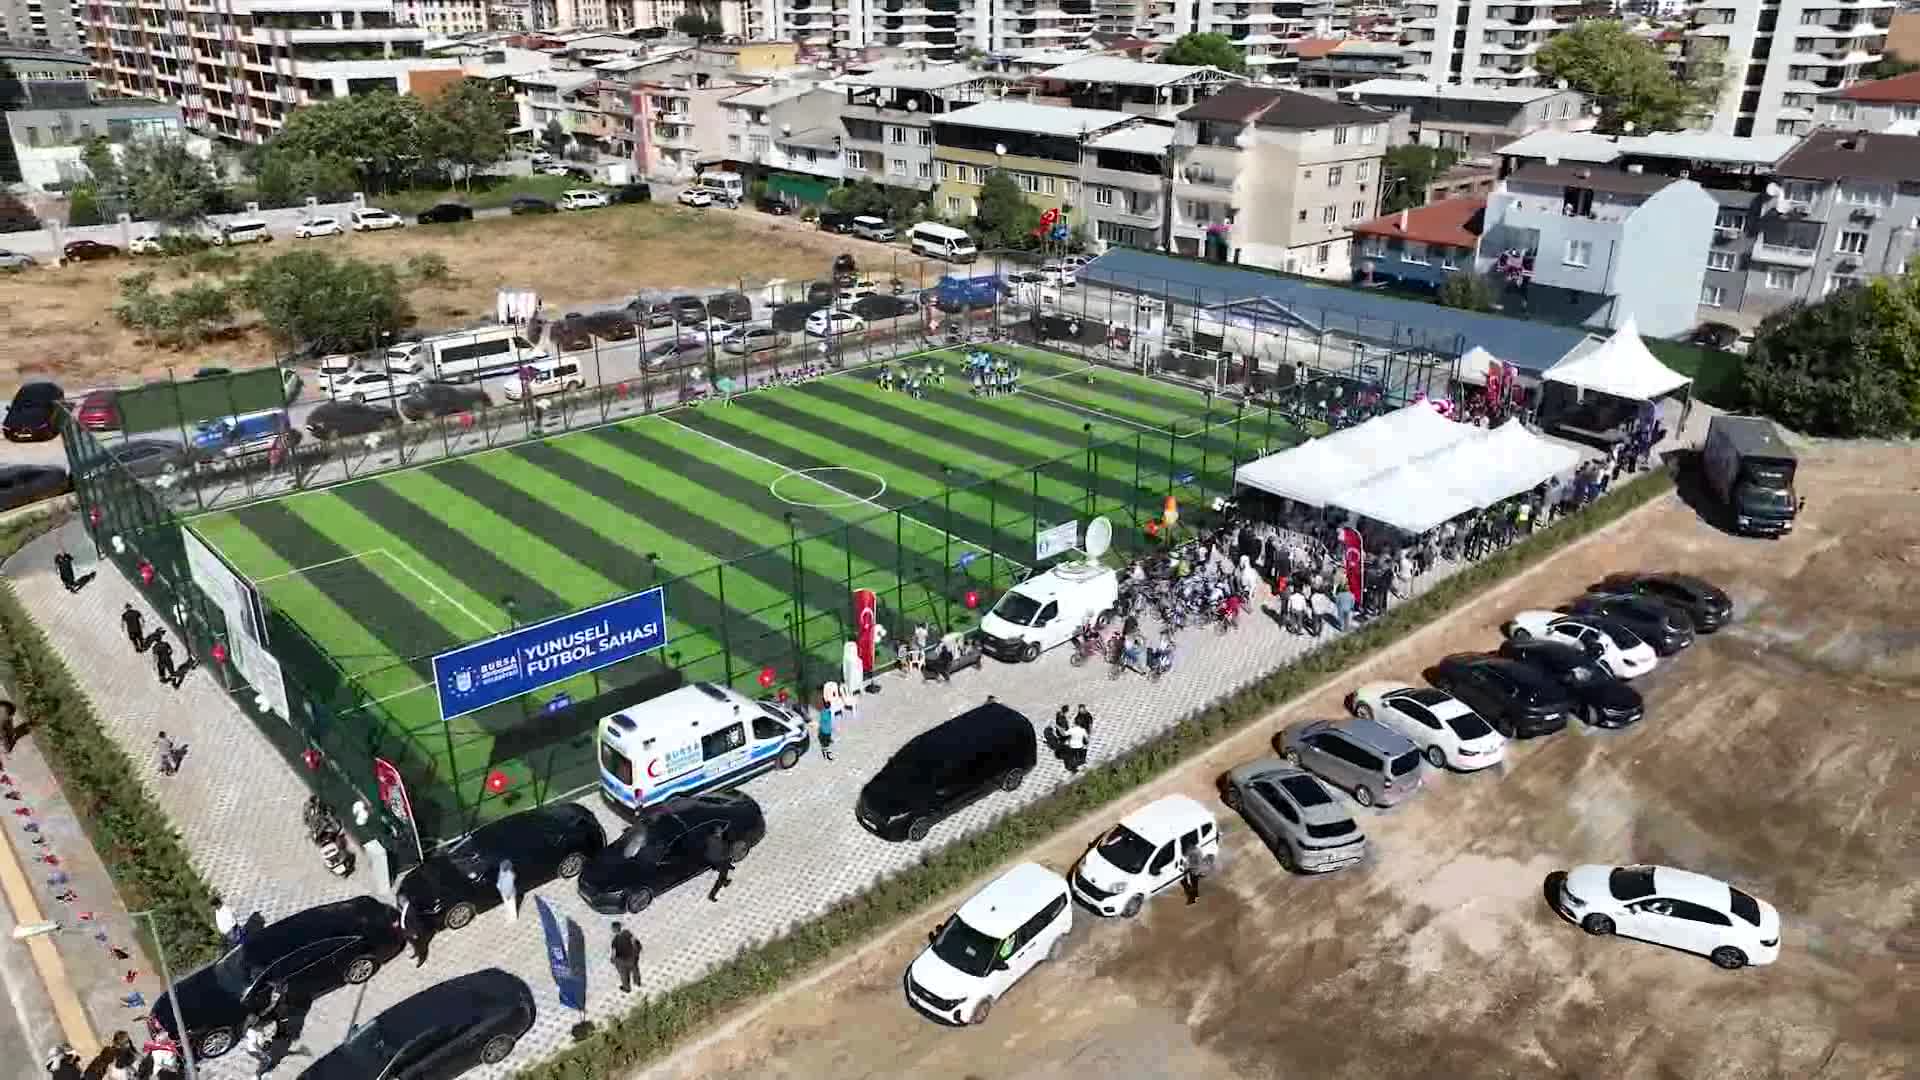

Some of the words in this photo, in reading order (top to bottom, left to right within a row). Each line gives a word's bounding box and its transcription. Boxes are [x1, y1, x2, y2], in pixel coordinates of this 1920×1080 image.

[524, 619, 610, 658] YUNUSELİ
[527, 646, 596, 677] FUTBOL
[599, 621, 658, 652] SAHASI
[481, 655, 517, 674] BURSA
